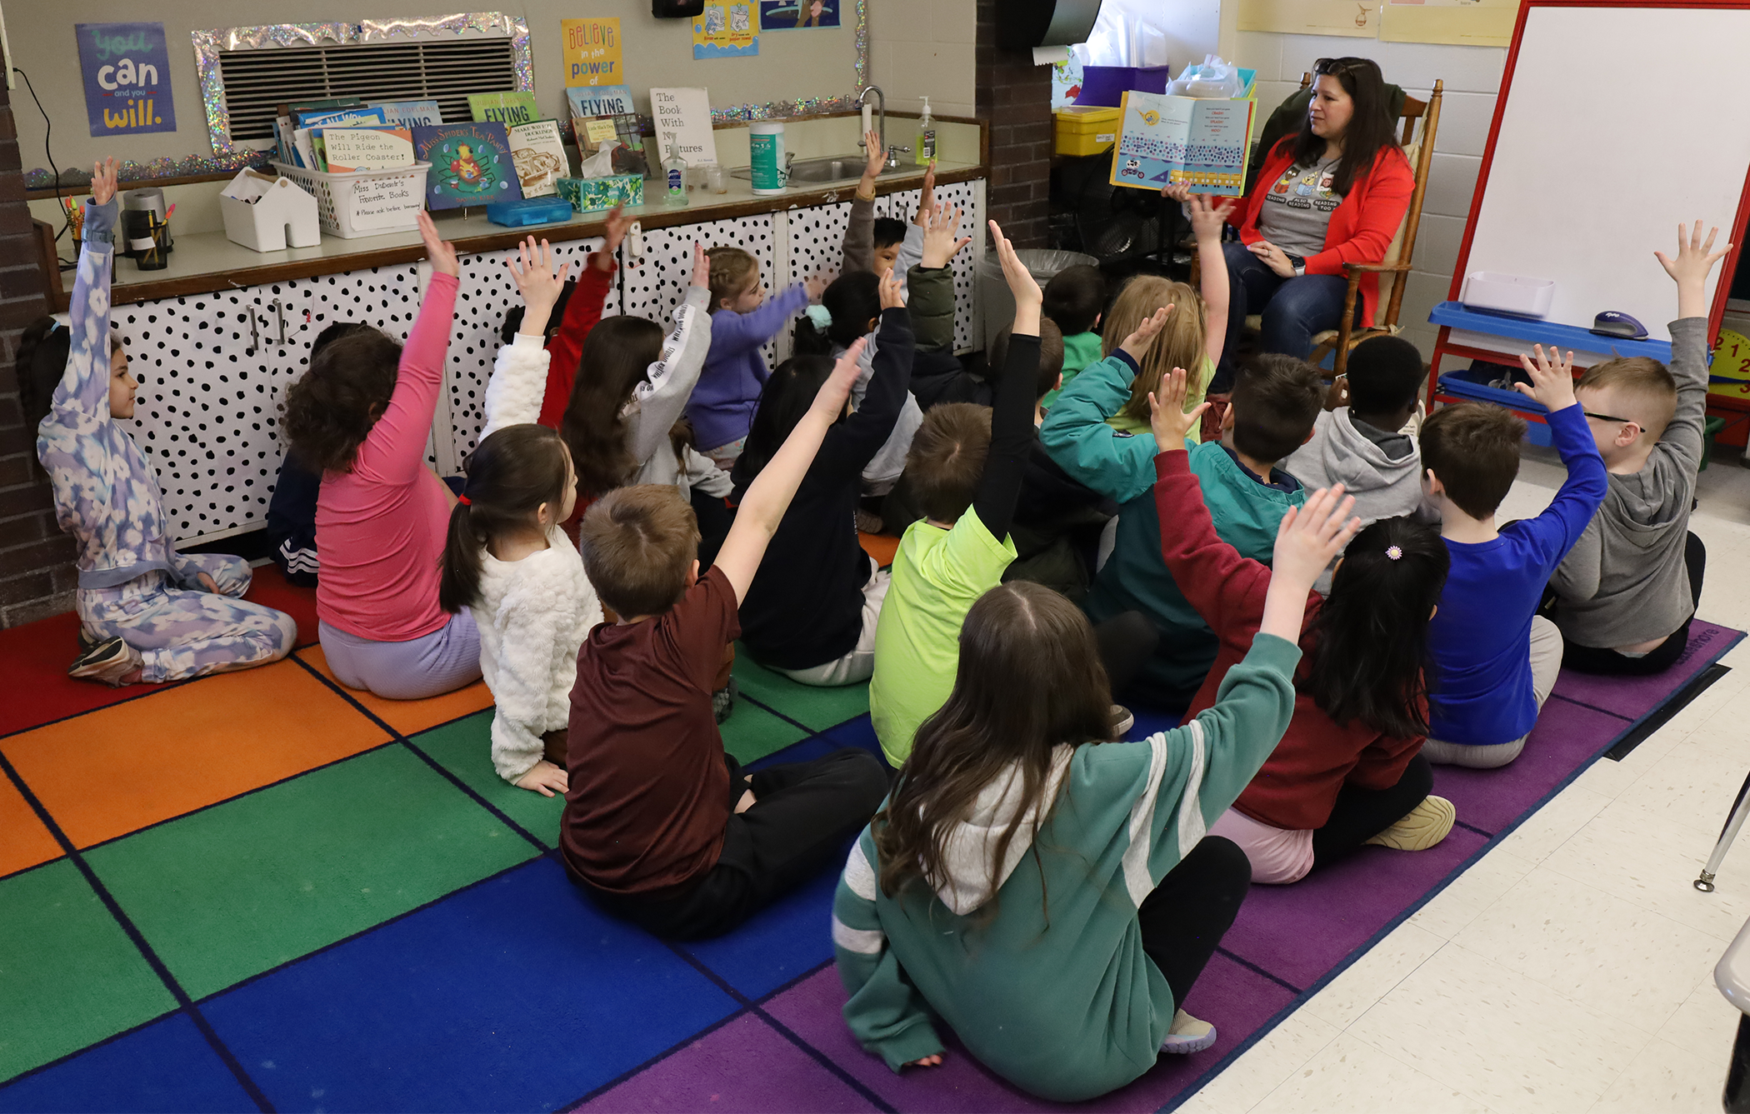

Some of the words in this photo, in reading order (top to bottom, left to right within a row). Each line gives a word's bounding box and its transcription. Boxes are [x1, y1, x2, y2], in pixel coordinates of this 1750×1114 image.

[91, 30, 153, 60] you
[581, 51, 589, 59] in
[591, 48, 605, 59] the
[97, 58, 158, 91] can
[571, 61, 615, 79] power
[589, 76, 599, 86] of
[114, 89, 130, 97] and
[131, 90, 146, 98] you
[656, 93, 675, 102] The
[383, 106, 399, 114] LIAN
[401, 105, 436, 113] EDELMAN
[580, 98, 625, 116] FLYING
[658, 105, 682, 115] Book
[103, 99, 162, 129] will.
[484, 105, 530, 123] FLYING
[660, 118, 685, 127] With
[329, 133, 345, 141] The
[350, 132, 381, 142] Pigeon
[525, 129, 553, 137] DUCKLINGS
[664, 144, 703, 154] Ptures
[332, 153, 361, 161] Roller
[365, 153, 405, 161] Coaster!
[353, 185, 369, 194] Miss
[358, 193, 386, 203] Favorite
[388, 189, 409, 199] Books
[1730, 344, 1739, 358] 1
[1738, 358, 1750, 373] 2
[1739, 379, 1750, 394] 3
